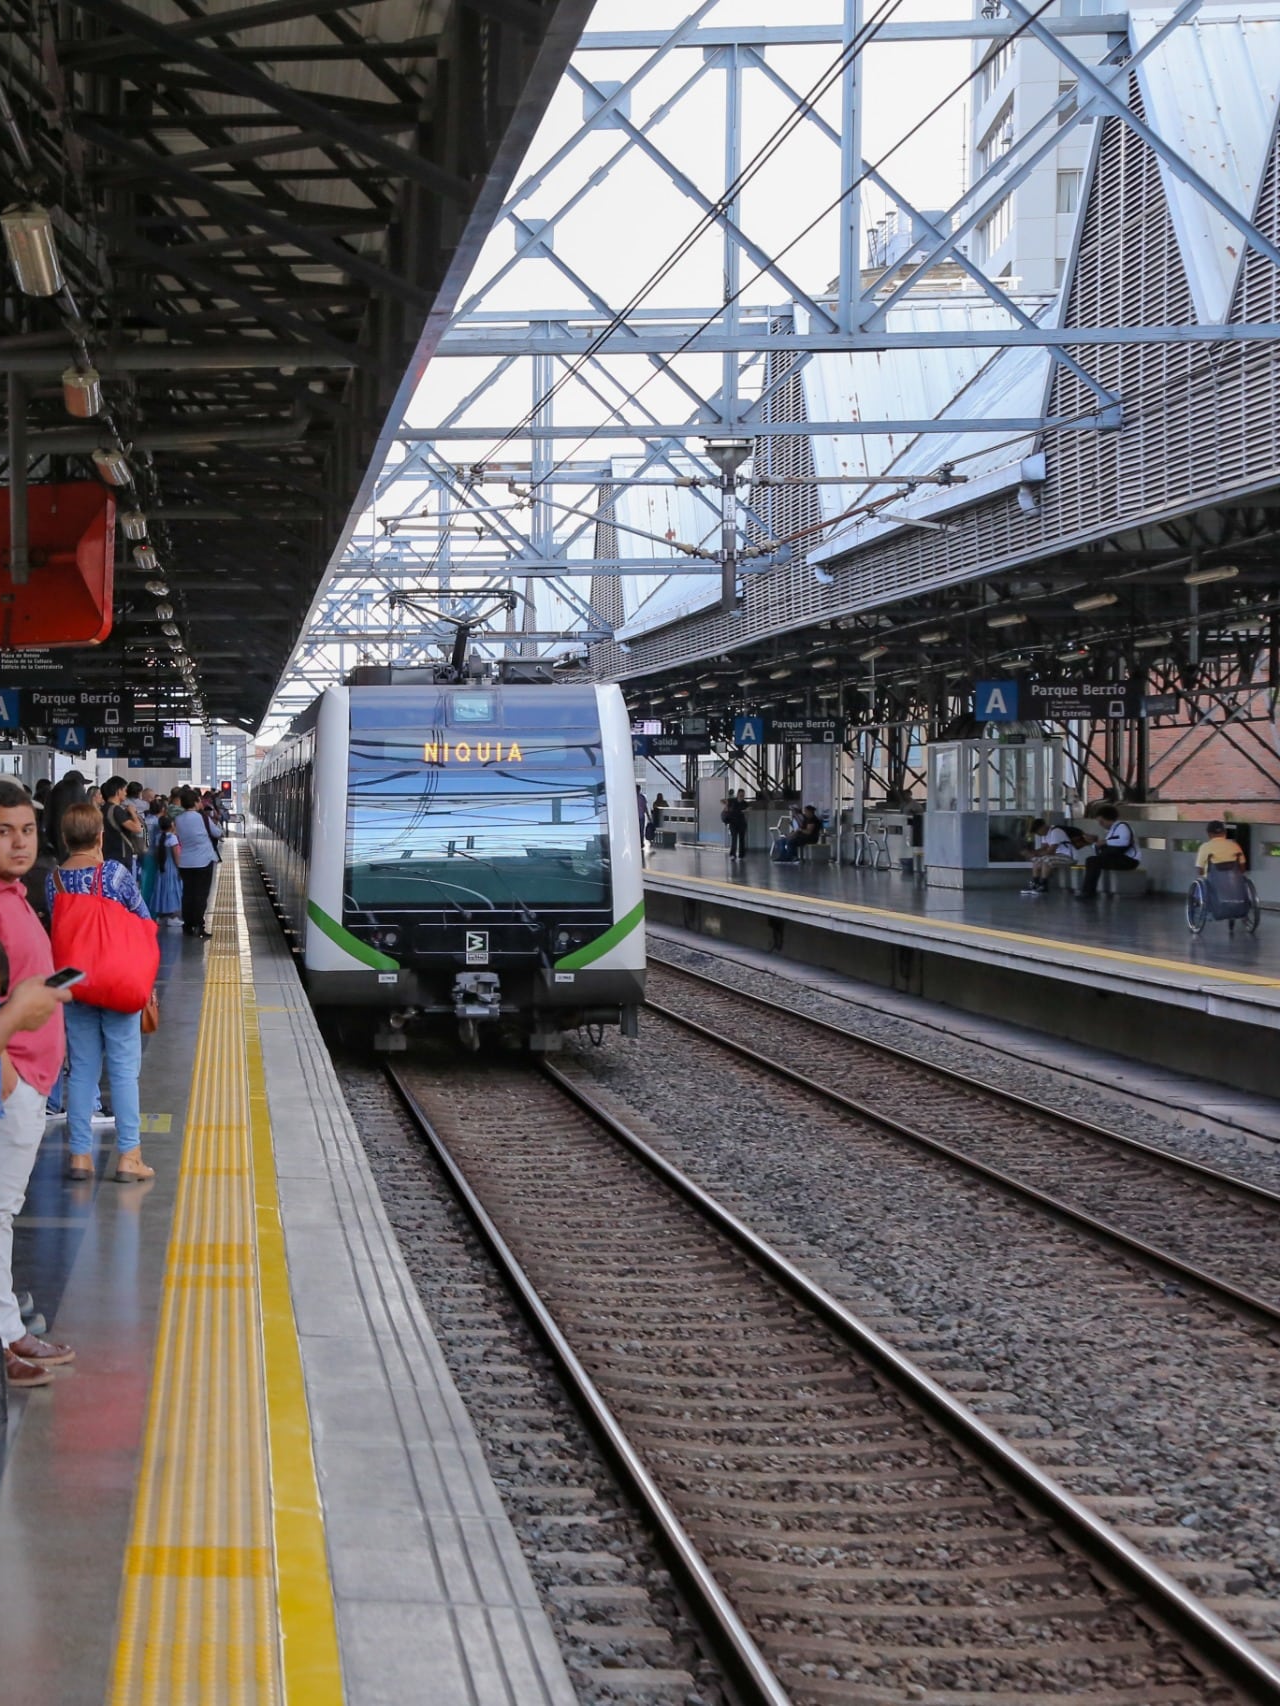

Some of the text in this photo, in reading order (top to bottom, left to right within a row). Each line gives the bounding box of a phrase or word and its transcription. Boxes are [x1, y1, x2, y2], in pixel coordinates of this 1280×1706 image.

[32, 692, 121, 706] Parque Berrío
[1031, 684, 1126, 698] Parque Berrío
[985, 688, 1008, 714] A
[740, 722, 756, 741] A
[772, 719, 836, 730] Parque Berrío
[64, 727, 79, 745] A
[652, 738, 678, 746] Salida
[424, 742, 522, 762] NIQUIA
